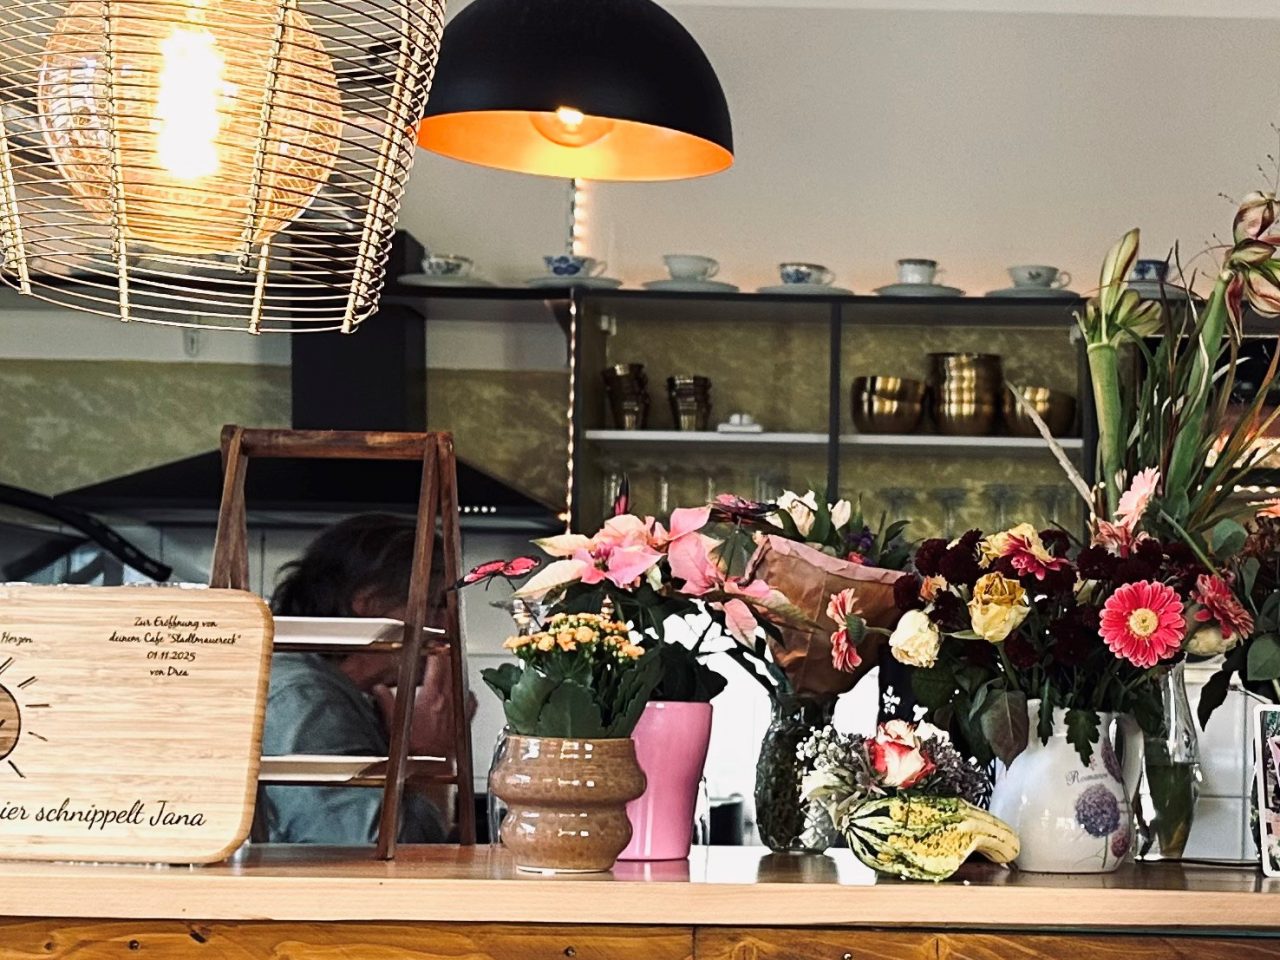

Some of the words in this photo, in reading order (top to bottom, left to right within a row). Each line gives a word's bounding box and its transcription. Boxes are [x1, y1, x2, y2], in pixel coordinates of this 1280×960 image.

[134, 616, 152, 627] Zur
[202, 620, 218, 628] von
[150, 669, 166, 677] von
[35, 797, 145, 831] schnippelt
[150, 800, 207, 827] Jana
